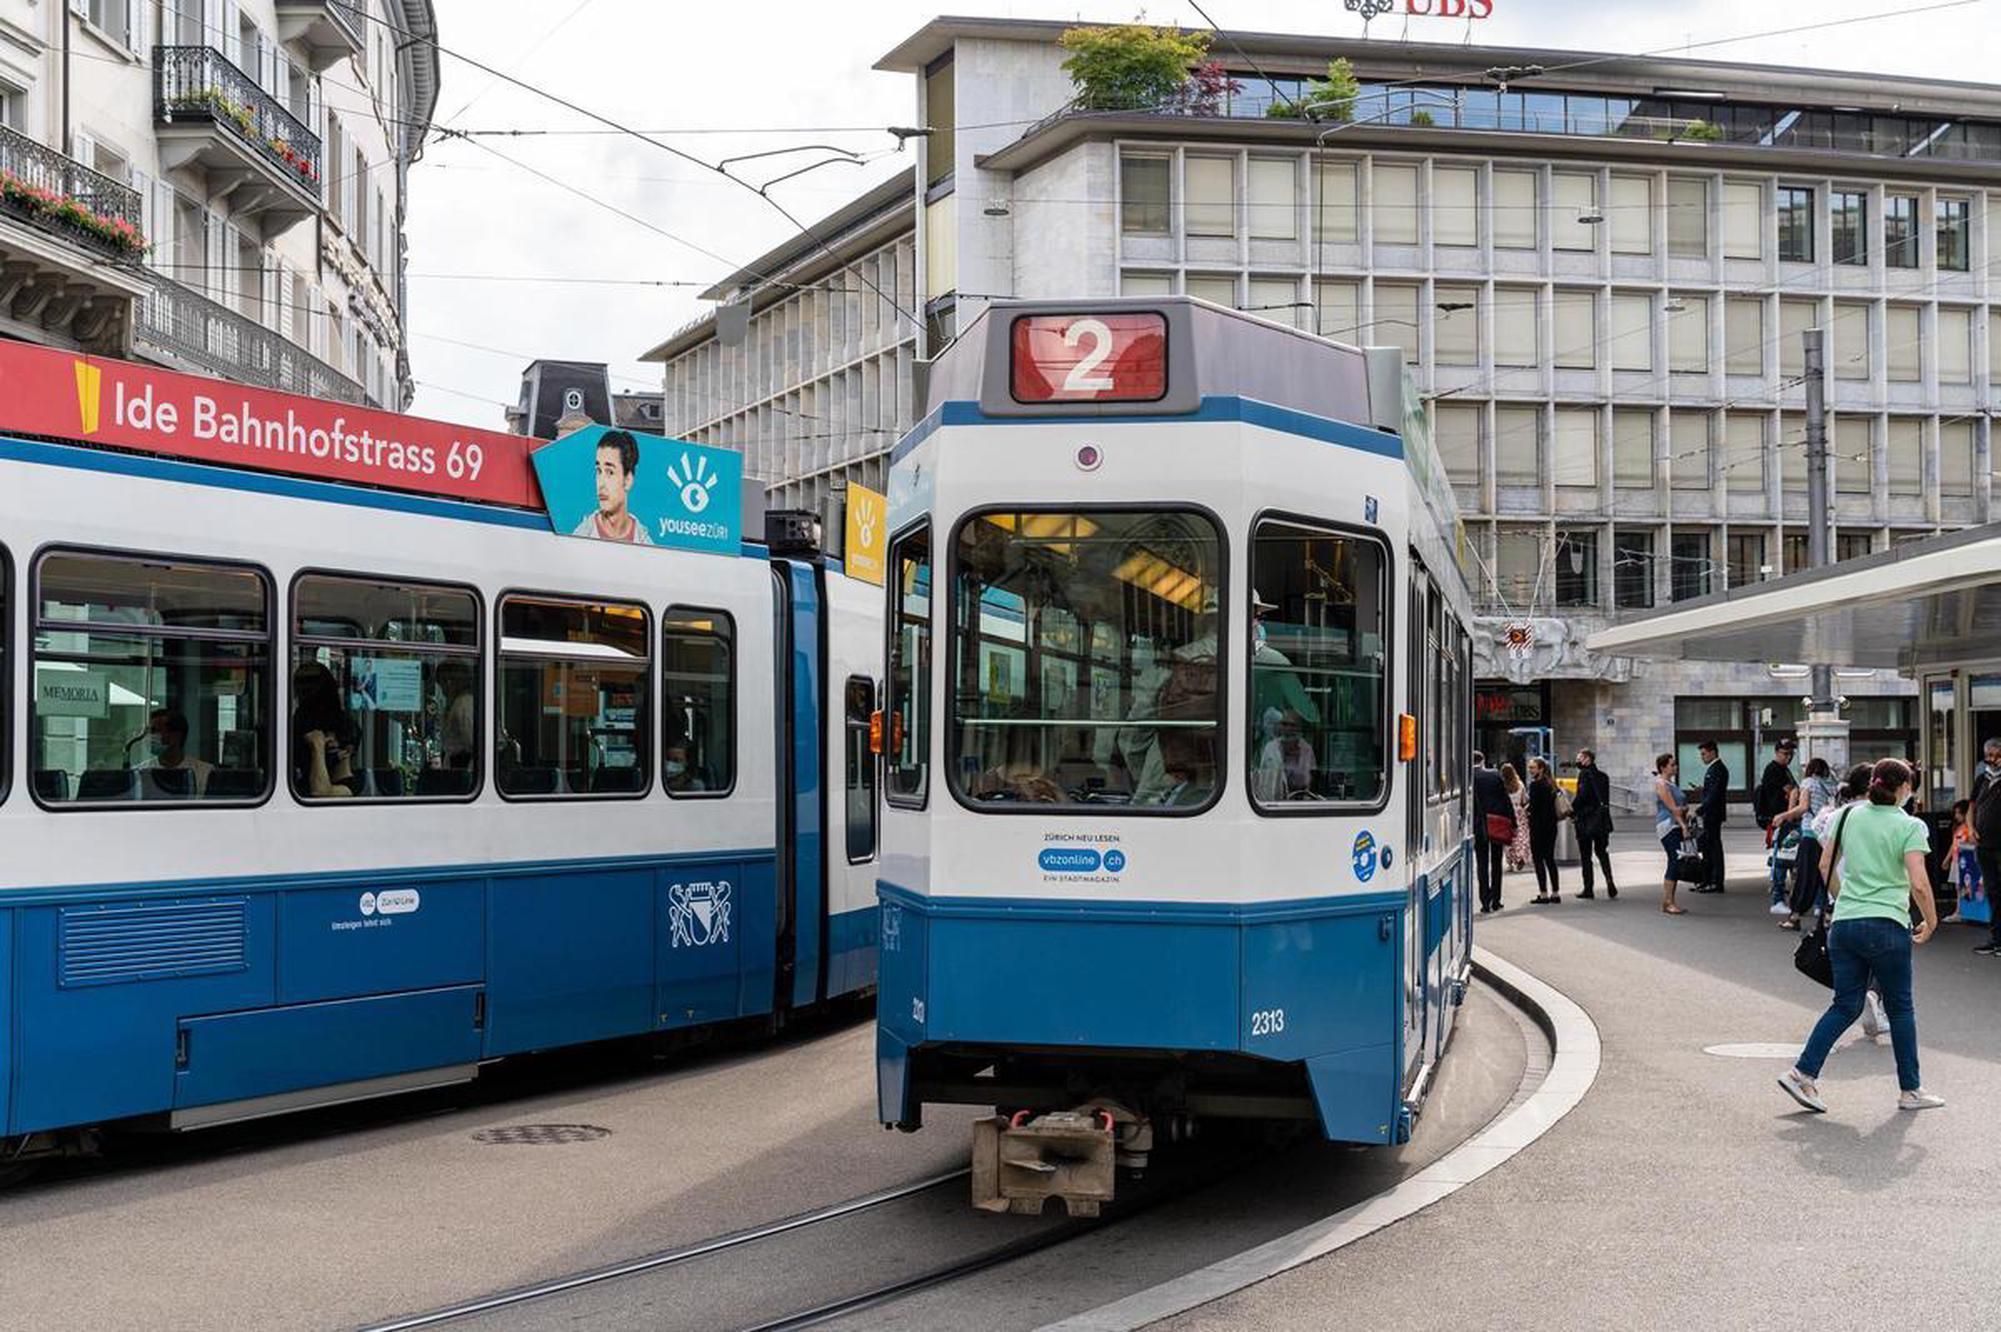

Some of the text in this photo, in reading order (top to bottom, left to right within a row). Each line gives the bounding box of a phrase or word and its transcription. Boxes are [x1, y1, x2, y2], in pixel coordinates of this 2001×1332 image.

[1062, 319, 1114, 391] 2
[115, 381, 484, 481] Ide Bahnhofstrass 69
[43, 685, 99, 702] MEMORIA
[1044, 833, 1120, 842] ZÜRICH NEU LESEN
[1251, 1008, 1284, 1036] 2313
